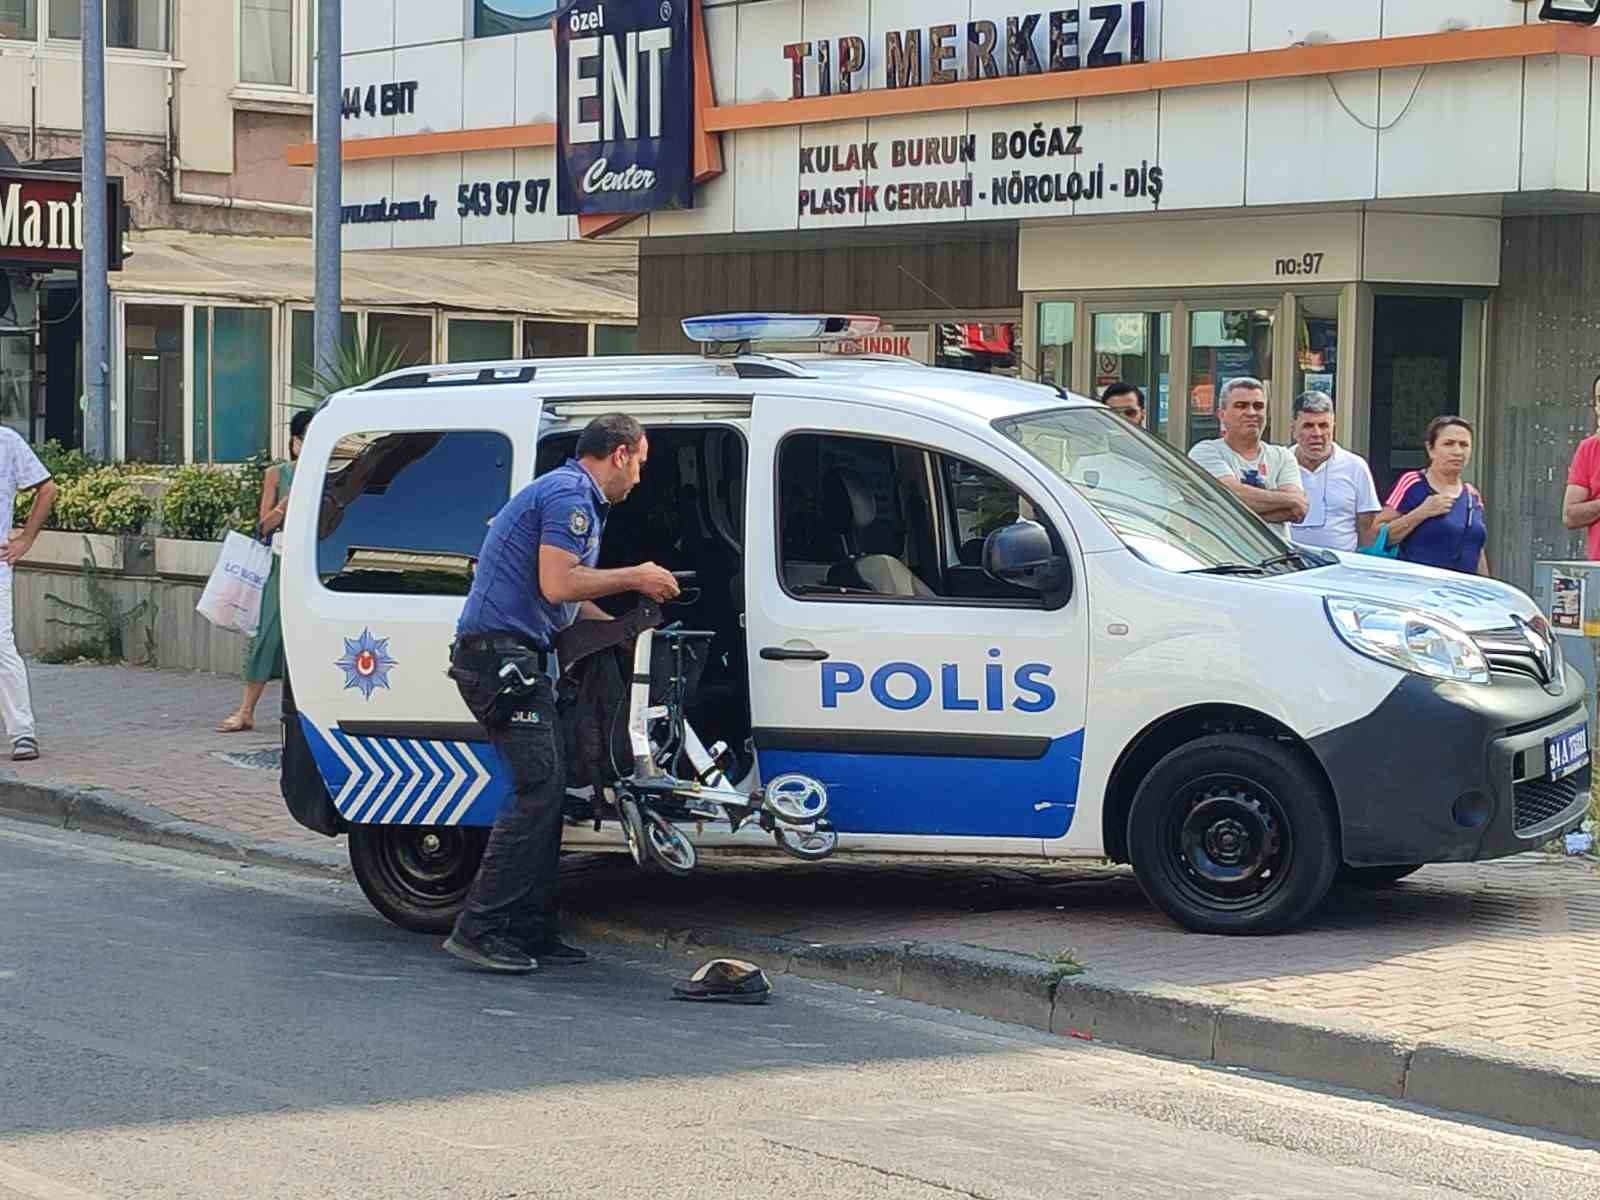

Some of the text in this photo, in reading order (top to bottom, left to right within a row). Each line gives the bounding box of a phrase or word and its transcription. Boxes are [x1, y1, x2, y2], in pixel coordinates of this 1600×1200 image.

[570, 5, 604, 32] özel
[569, 27, 672, 144] ENT
[784, 37, 866, 100] TIP
[800, 122, 1083, 174] KULAK BURUN BOĞAZ
[457, 183, 492, 217] 543
[496, 180, 520, 215] 97
[525, 178, 551, 213] 97
[583, 157, 656, 193] Center
[799, 179, 879, 215] PLASTİK
[992, 163, 1103, 204] NÖROLOJİ
[1124, 160, 1164, 210] DİŞ
[1275, 252, 1324, 275] no:97
[820, 647, 1056, 712] POLİS
